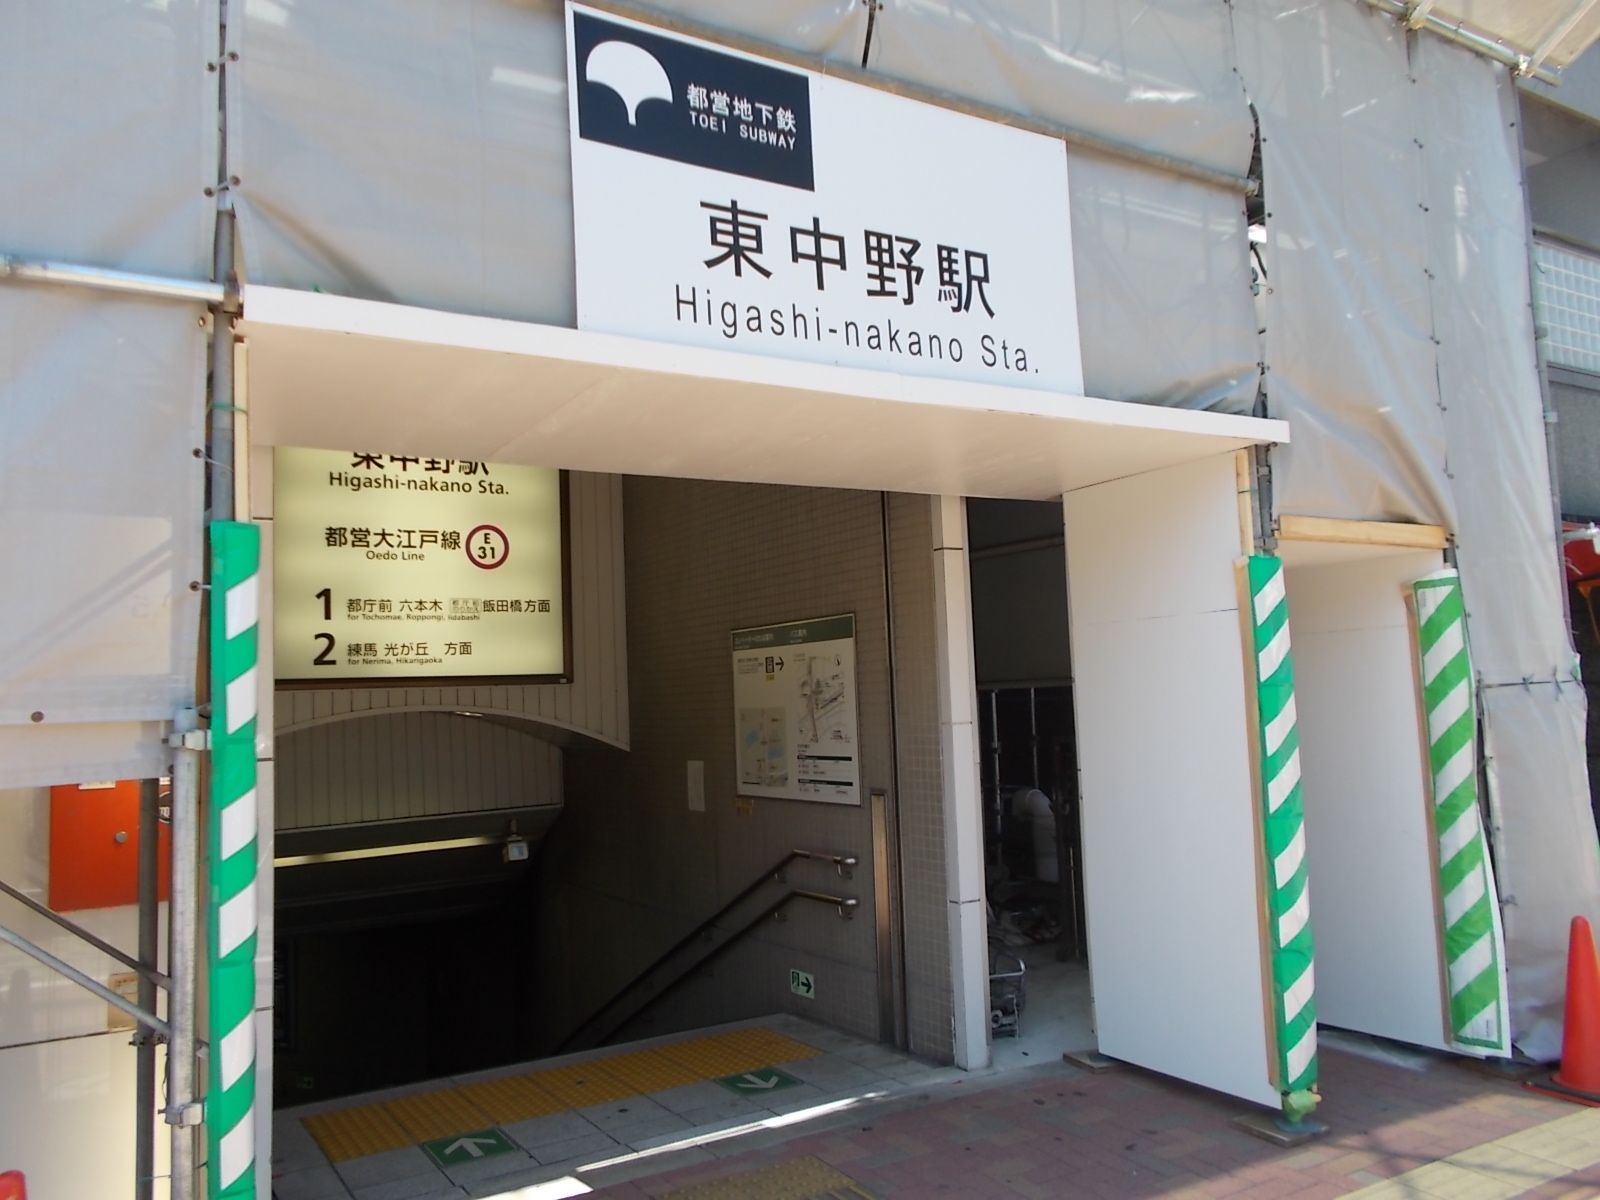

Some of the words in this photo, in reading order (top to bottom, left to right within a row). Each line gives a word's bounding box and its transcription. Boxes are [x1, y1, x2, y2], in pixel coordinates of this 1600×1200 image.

[687, 82, 796, 133] 都営地下鉄
[690, 110, 726, 134] TOEI
[739, 124, 795, 151] SUBWAY
[699, 199, 995, 319] 東中野駅
[675, 284, 964, 364] Higashi-nakano
[981, 335, 1040, 373] Sta.
[329, 472, 473, 492] Higashi-nakano
[478, 480, 510, 495] Sta.
[325, 526, 461, 551] 都営大江戸線
[483, 533, 492, 545] E
[366, 550, 398, 561] Oedo
[401, 550, 425, 561] Line
[477, 547, 496, 560] 31
[315, 588, 332, 620] 1
[346, 598, 392, 613] 都庁前
[399, 599, 443, 613] 六本木
[347, 613, 359, 621] for
[313, 633, 336, 666] 2
[347, 643, 377, 658] 練馬
[384, 642, 429, 657] 光が丘
[444, 641, 473, 656] 方面
[347, 657, 359, 666] for
[396, 656, 443, 666] Hikarigaoka
